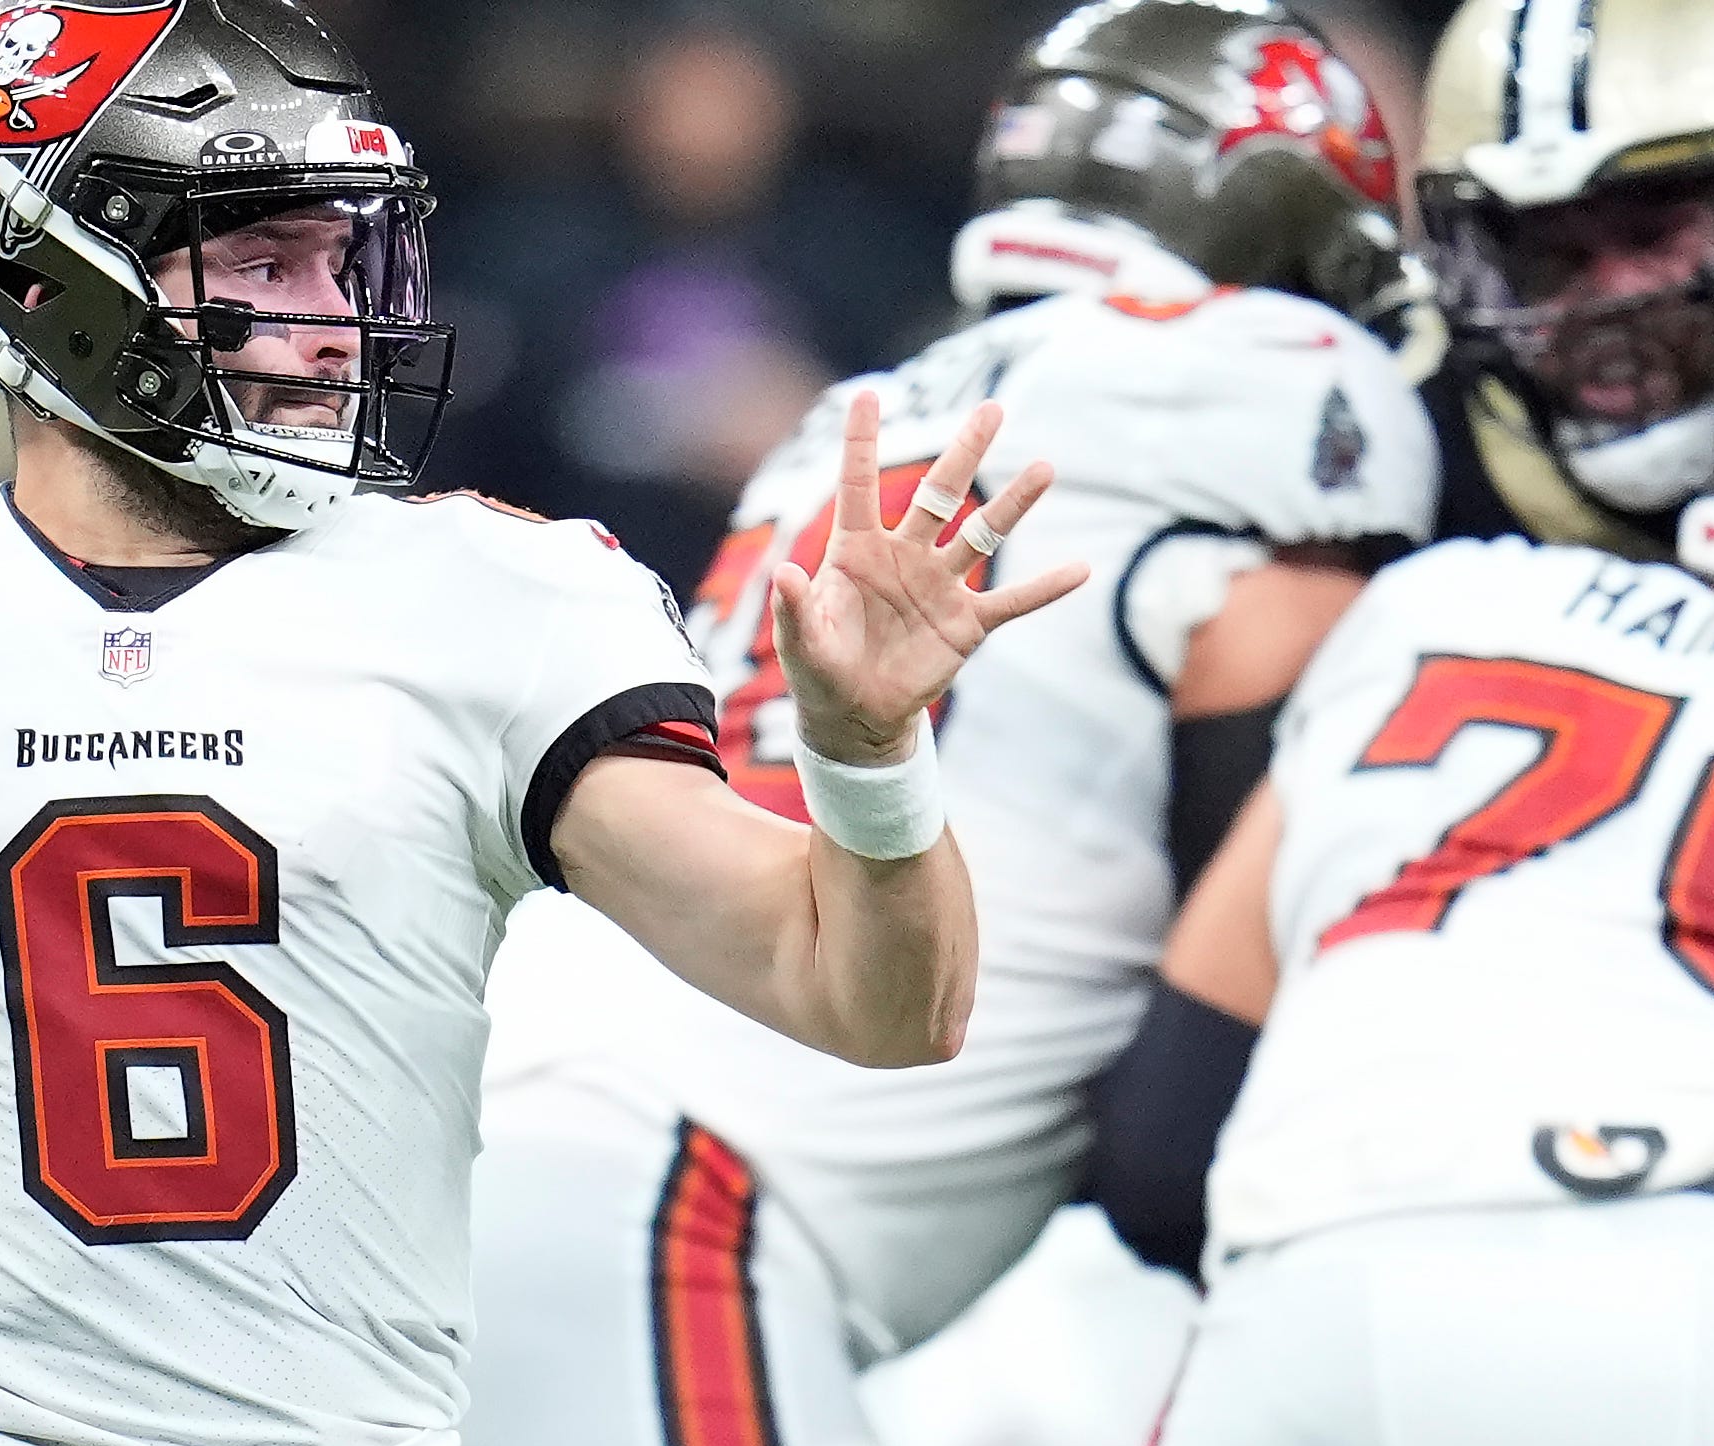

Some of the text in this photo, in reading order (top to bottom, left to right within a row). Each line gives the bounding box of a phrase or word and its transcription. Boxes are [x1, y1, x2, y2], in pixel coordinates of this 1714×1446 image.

[202, 152, 279, 165] OAKLEY
[108, 649, 145, 670] NFL
[15, 728, 243, 770] BUCCANEERS
